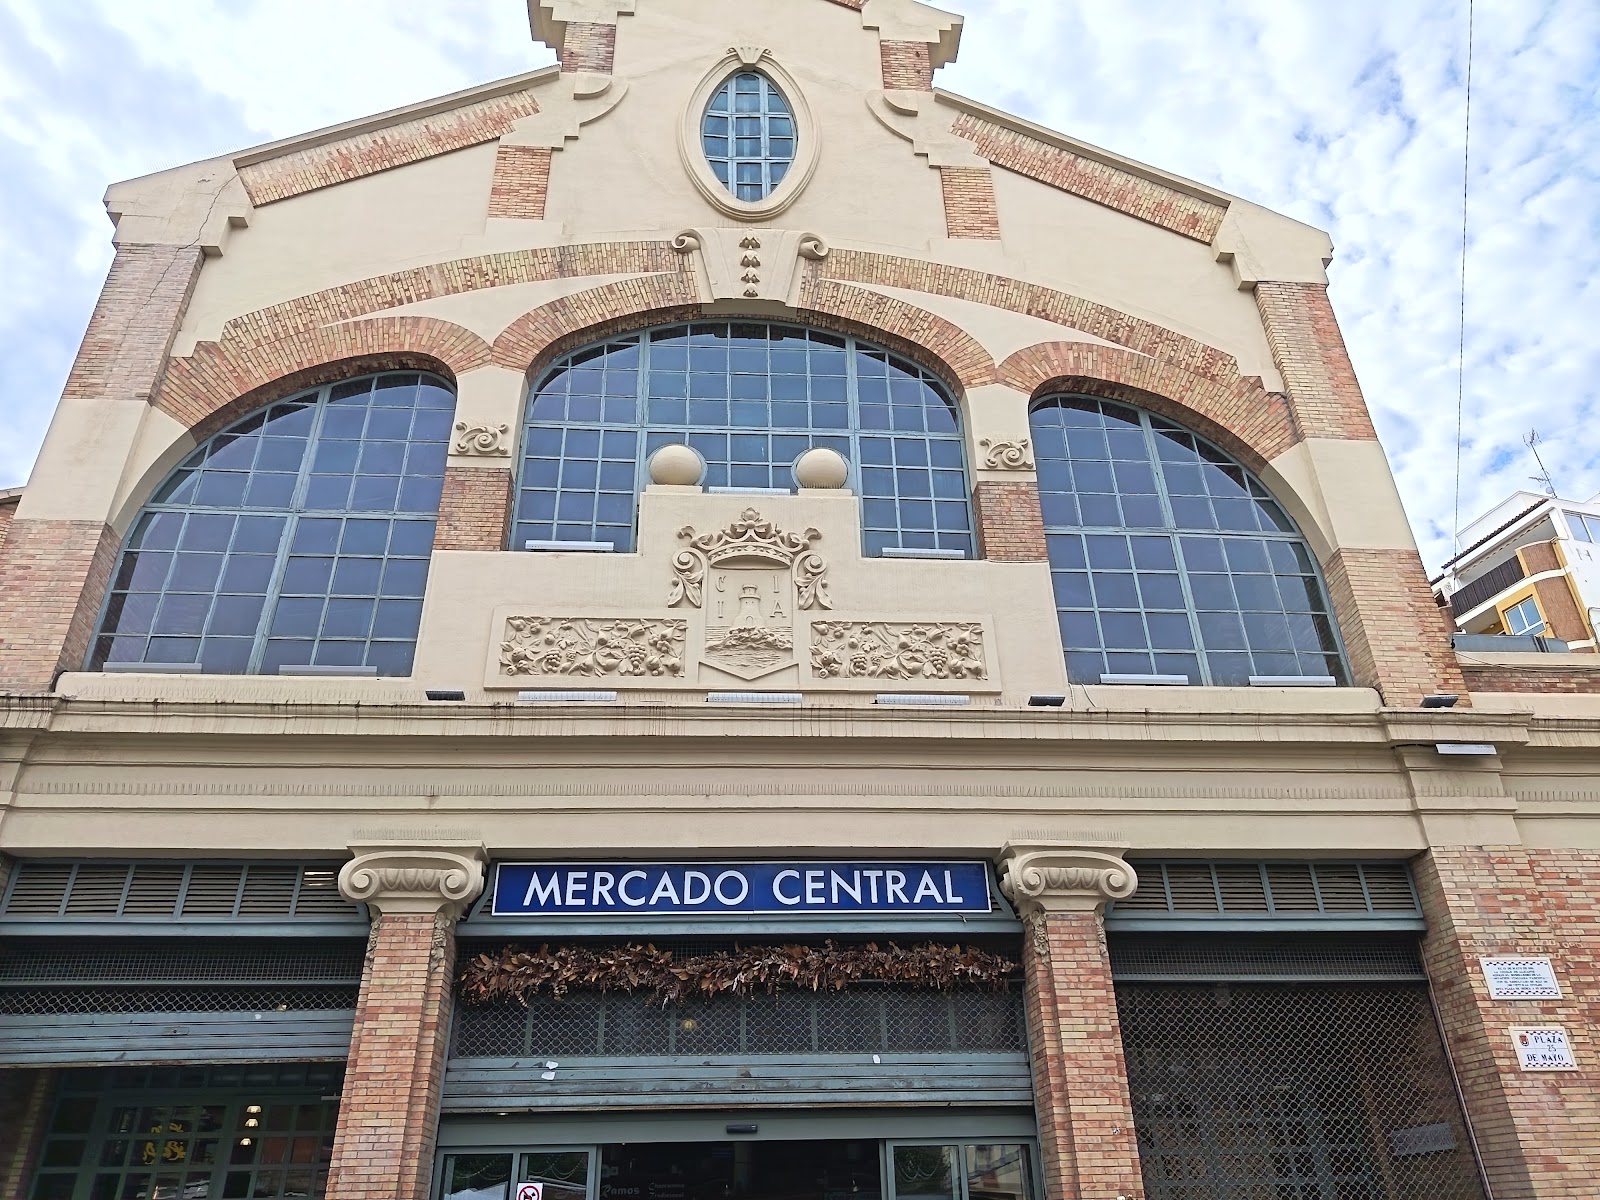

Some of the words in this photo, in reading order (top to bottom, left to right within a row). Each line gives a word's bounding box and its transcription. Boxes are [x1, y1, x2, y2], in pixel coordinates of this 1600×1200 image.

[522, 869, 750, 906] MERCADO
[771, 868, 964, 905] CENTRAL
[1533, 1035, 1563, 1044] PLAZA
[1546, 1044, 1557, 1052] 25
[1526, 1053, 1539, 1062] DE
[1540, 1053, 1564, 1062] MAYO
